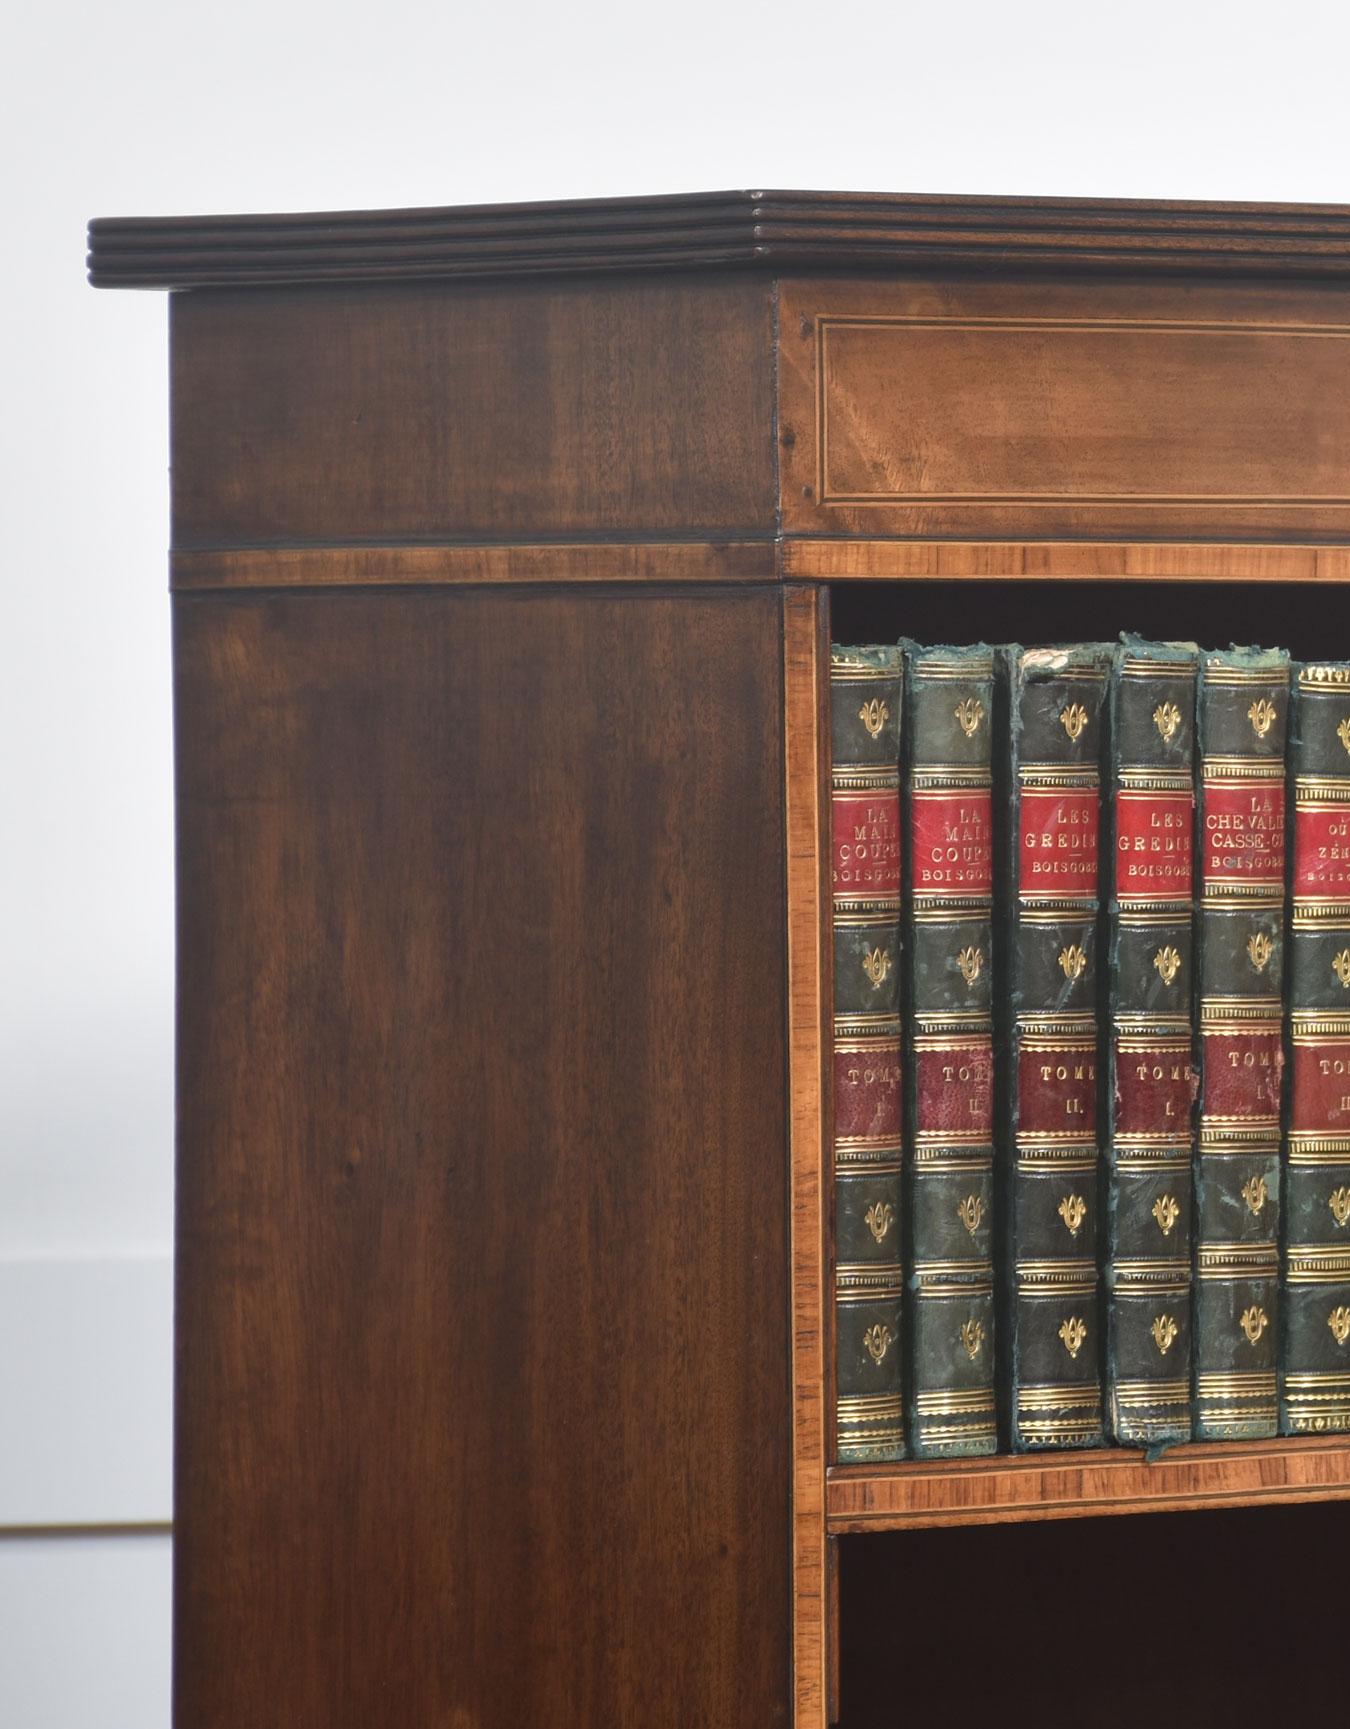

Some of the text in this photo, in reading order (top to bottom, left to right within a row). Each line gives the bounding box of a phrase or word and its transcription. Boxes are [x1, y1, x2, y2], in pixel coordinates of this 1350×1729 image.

[867, 808, 889, 823] LA
[960, 809, 981, 823] LA
[1058, 809, 1090, 824] LES
[1151, 812, 1183, 827] LES
[1136, 1065, 1191, 1081] TOME
[1066, 1099, 1084, 1114] II.
[1165, 1102, 1175, 1116] I.
